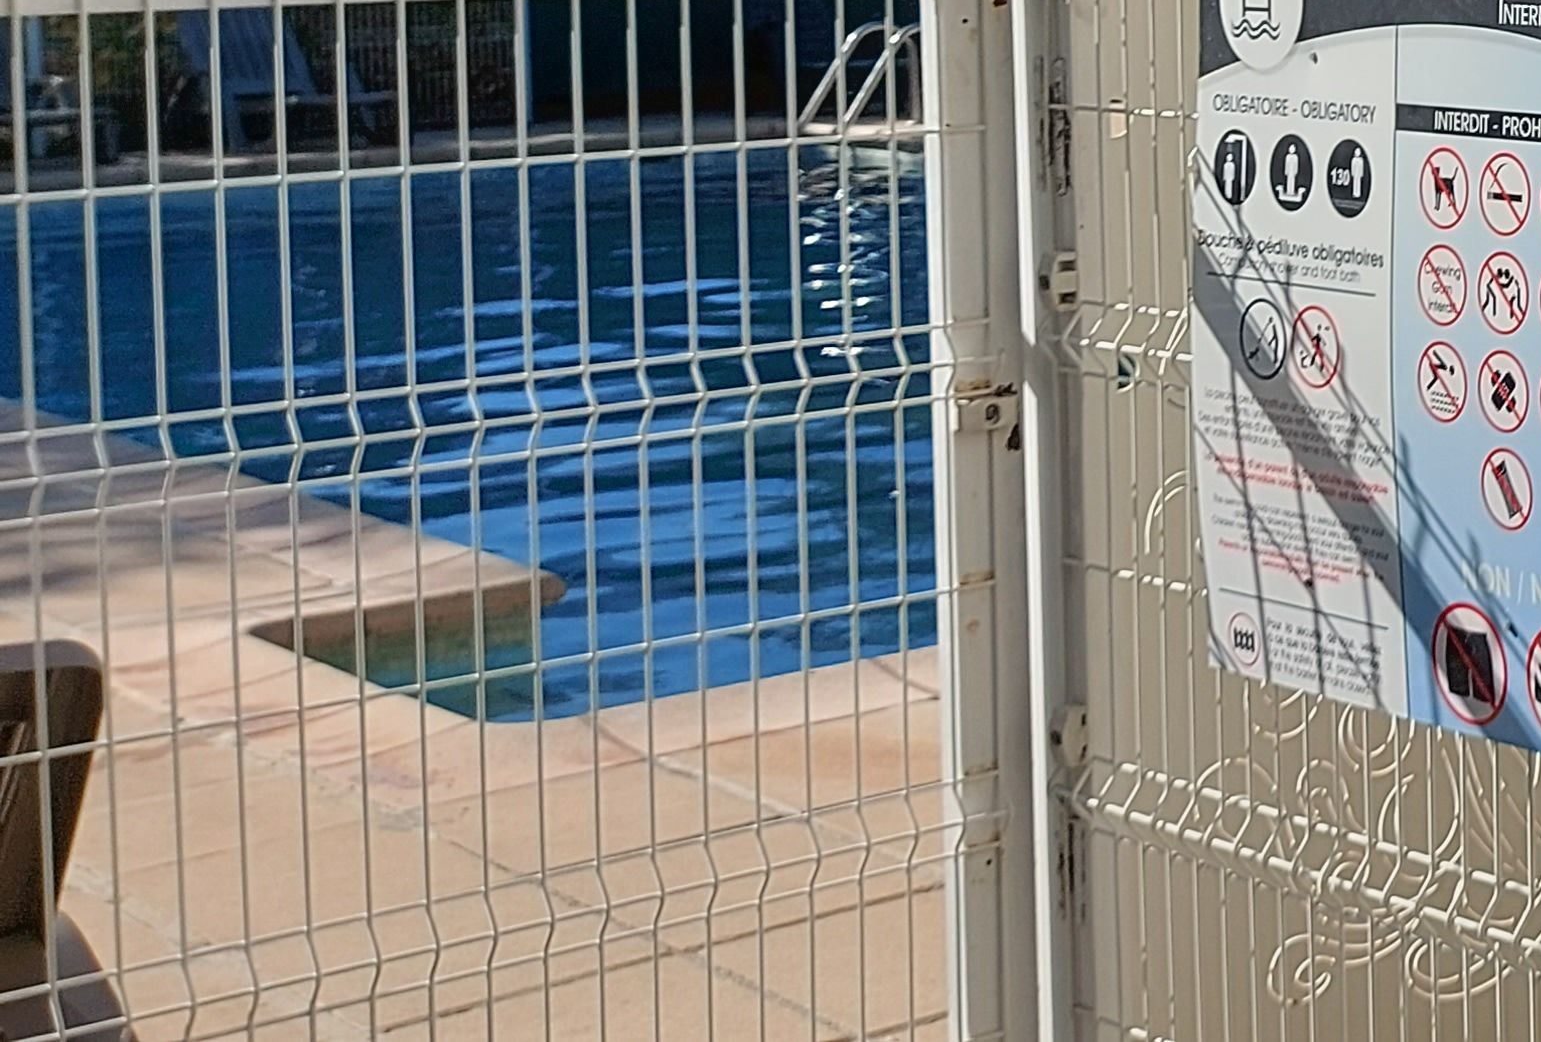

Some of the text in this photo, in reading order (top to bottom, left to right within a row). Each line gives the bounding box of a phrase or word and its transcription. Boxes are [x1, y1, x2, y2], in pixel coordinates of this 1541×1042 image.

[1213, 93, 1376, 124] OBLIGATOIRE OBLIGATORY
[1434, 110, 1490, 134] INTERDIT
[1330, 166, 1350, 187] 130
[1312, 242, 1384, 269] obligatoires
